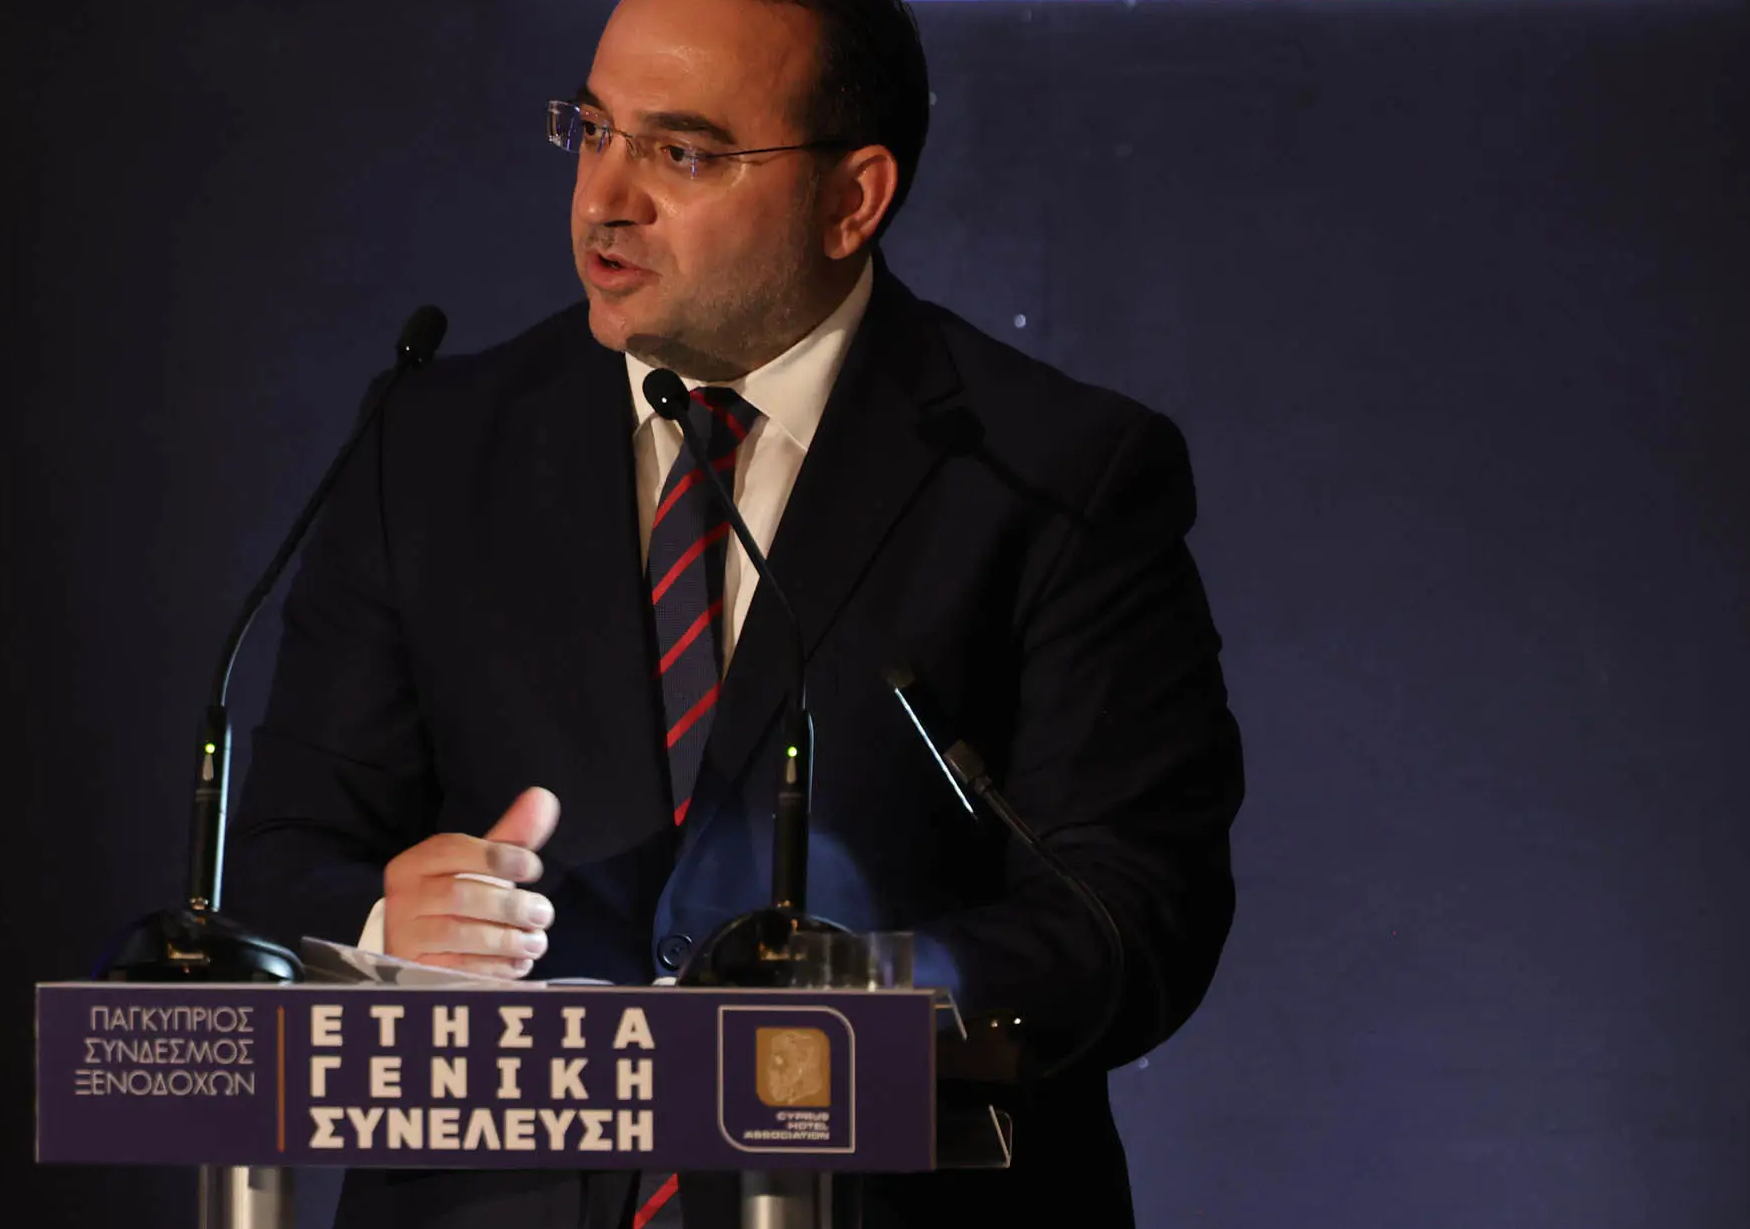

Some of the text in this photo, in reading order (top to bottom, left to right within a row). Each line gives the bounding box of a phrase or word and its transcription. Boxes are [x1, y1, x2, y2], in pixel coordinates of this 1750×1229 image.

[91, 1006, 254, 1032] ΠΑΓΚΥΠΡΙΟΣ
[311, 1005, 655, 1049] ΕΤΗΣΙΑ
[83, 1038, 254, 1064] ΣΥΝΔΕΣΜΟΣ
[74, 1070, 256, 1096] ΞΕΝΟΔΟΧΩΝ
[311, 1056, 654, 1100] ΓΕΝΙΚΗ
[309, 1107, 654, 1151] ΣΥΝΕΛΕΥΣΗ
[787, 1122, 829, 1131] HOTEL
